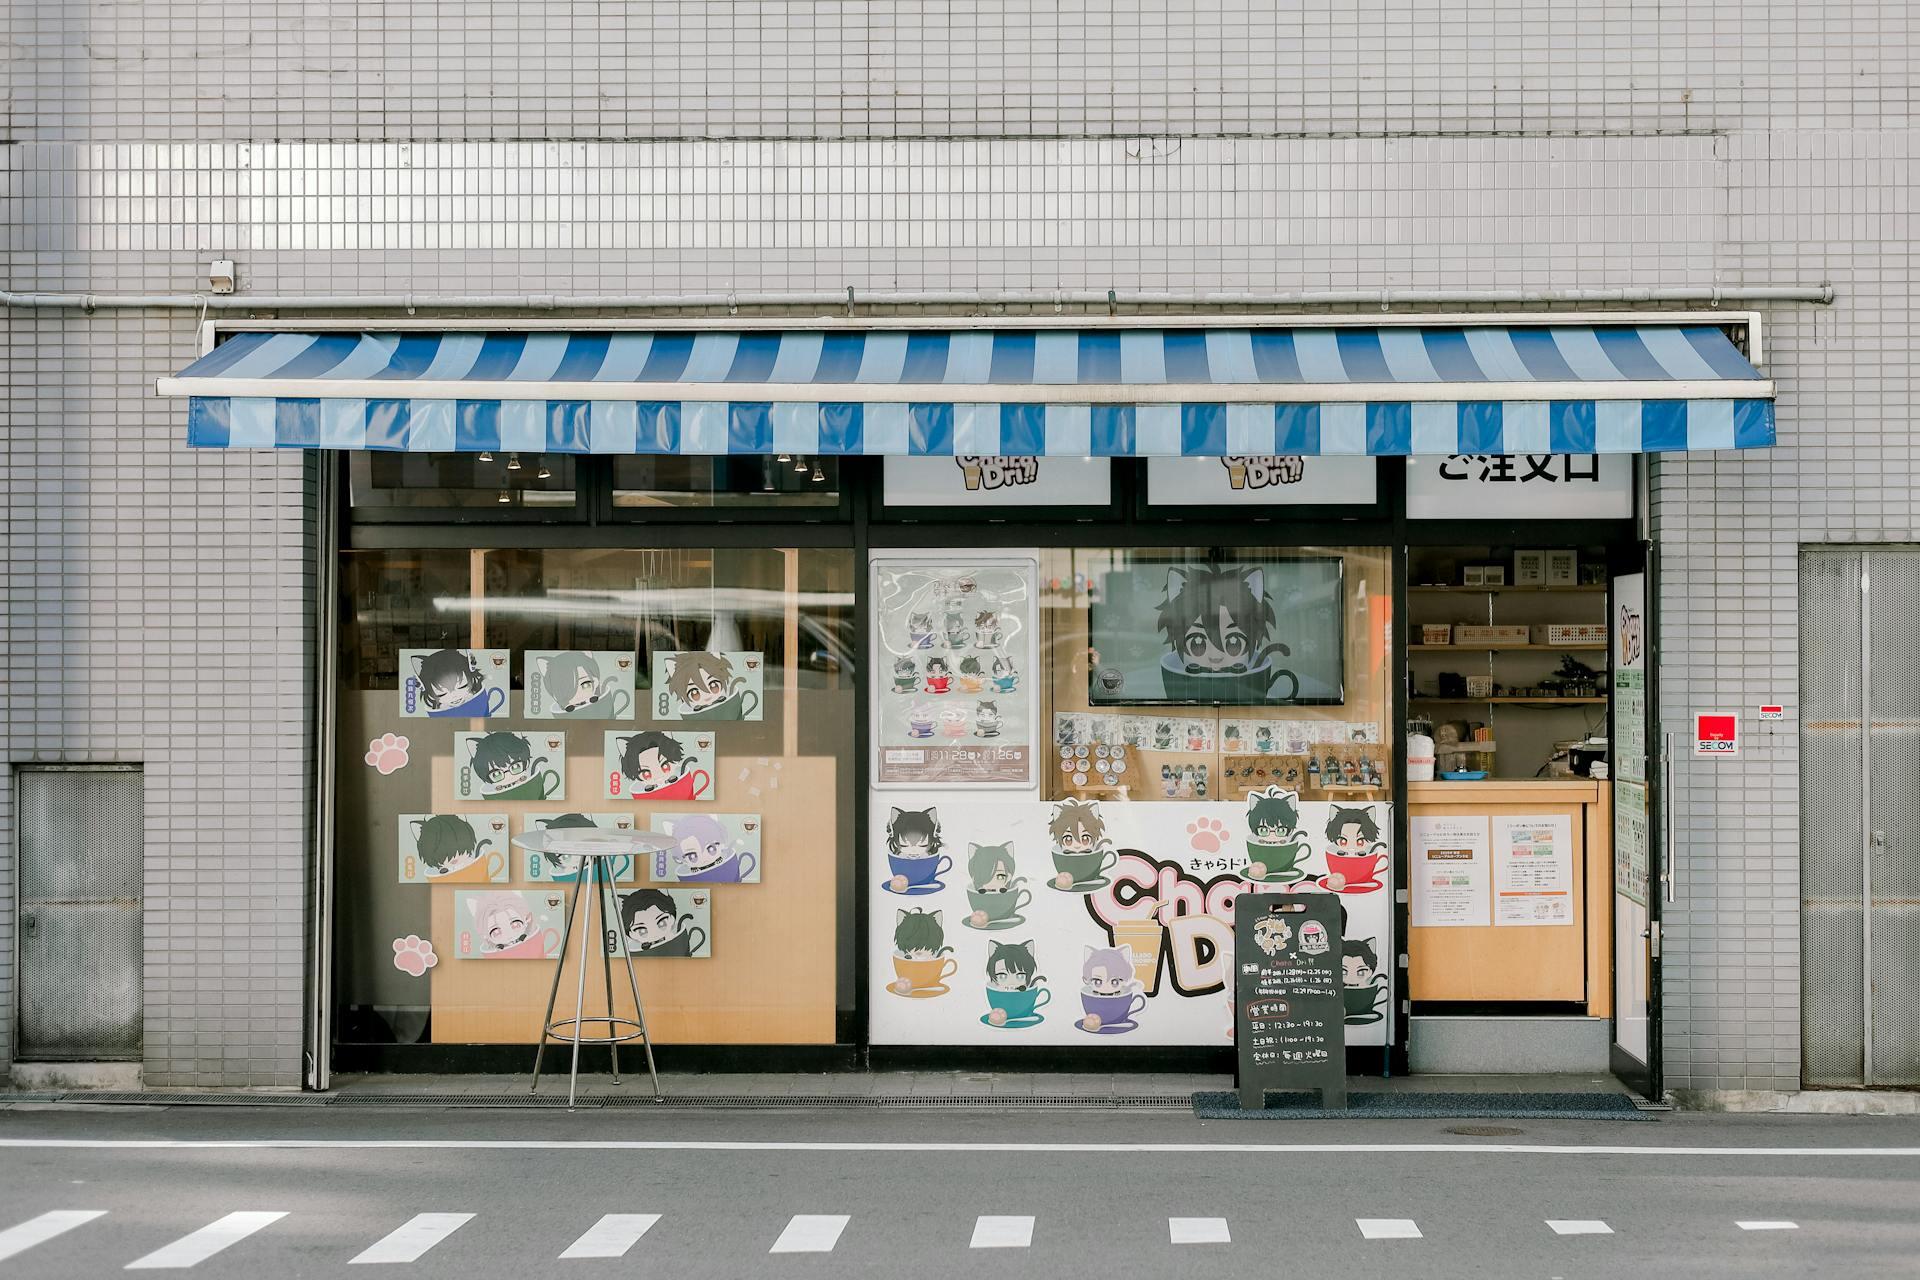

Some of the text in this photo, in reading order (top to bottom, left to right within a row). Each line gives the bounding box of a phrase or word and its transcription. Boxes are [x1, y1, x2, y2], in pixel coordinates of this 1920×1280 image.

[1439, 454, 1599, 482] ご注文口
[1700, 741, 1734, 750] SECOM
